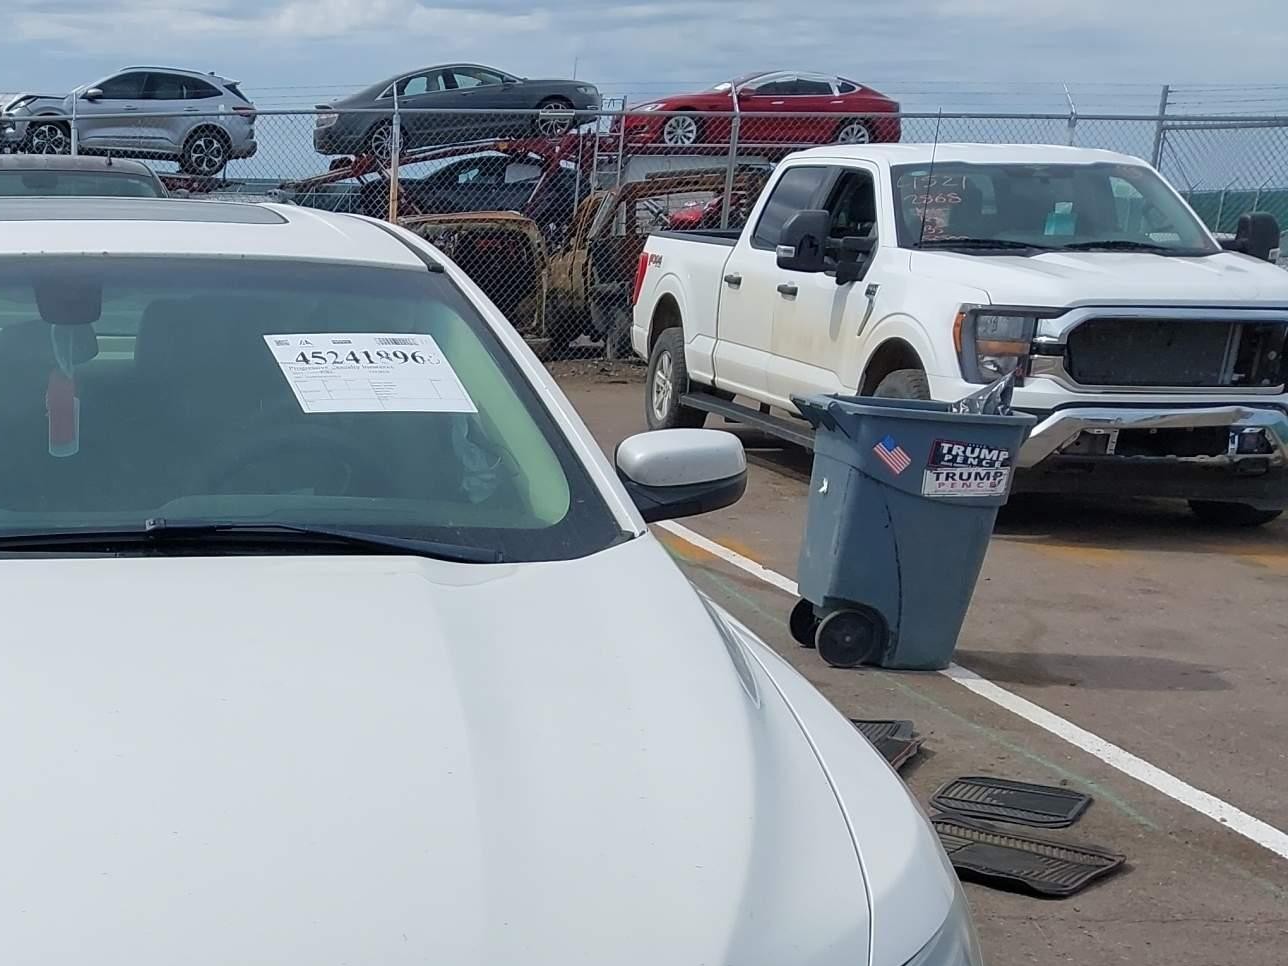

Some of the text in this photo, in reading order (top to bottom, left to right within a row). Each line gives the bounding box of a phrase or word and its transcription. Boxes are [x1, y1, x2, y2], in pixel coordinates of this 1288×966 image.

[295, 350, 426, 365] 45241896
[940, 443, 1009, 460] TRUMP
[944, 454, 1002, 468] PENCE
[932, 471, 1004, 482] TRUMP
